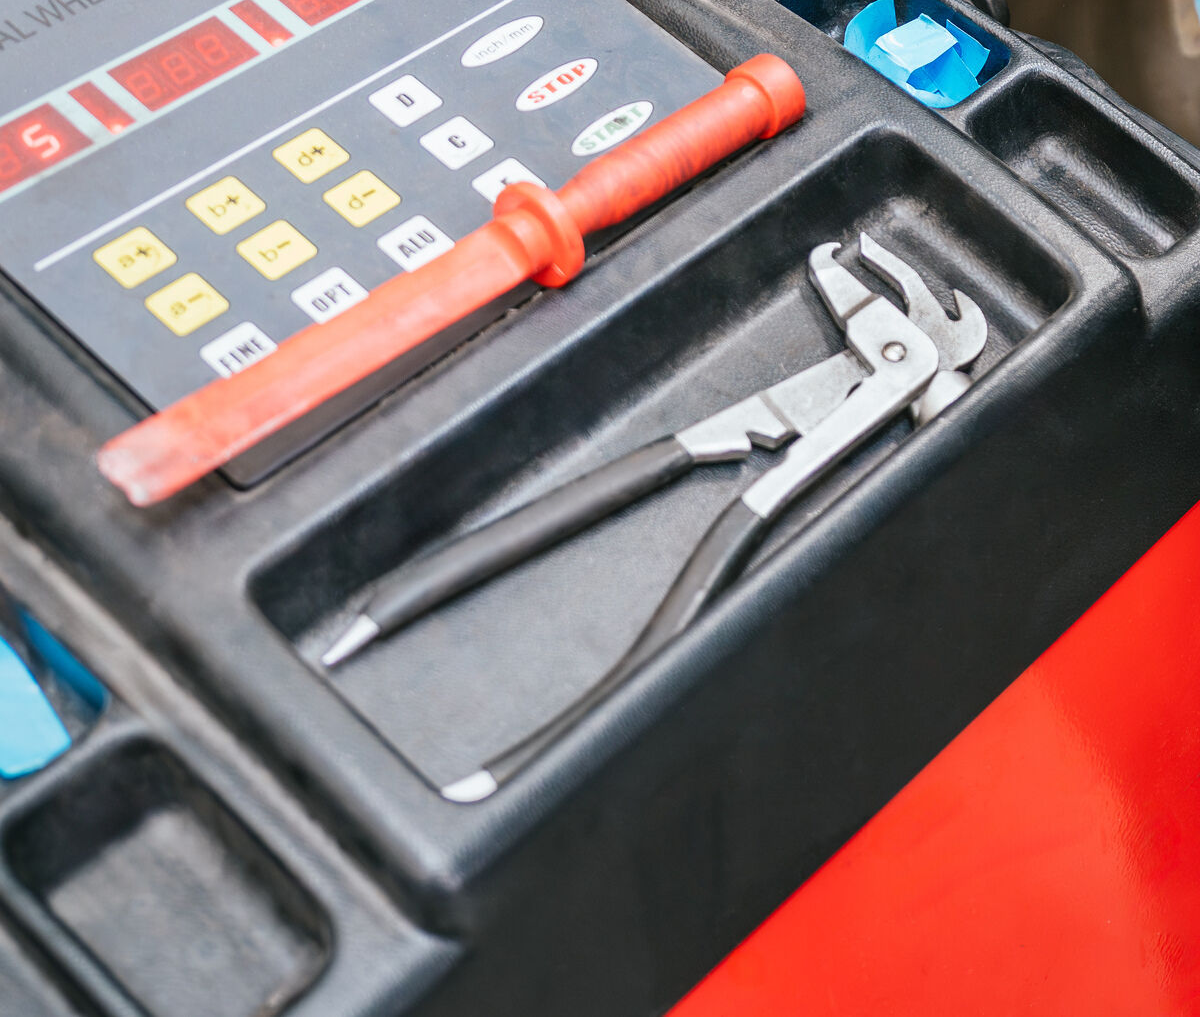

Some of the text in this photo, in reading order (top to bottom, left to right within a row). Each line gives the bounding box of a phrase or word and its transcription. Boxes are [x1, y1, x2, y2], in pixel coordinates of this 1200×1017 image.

[475, 22, 534, 60] inch/mm
[527, 63, 586, 103] STOP
[396, 93, 415, 107] D
[579, 105, 644, 151] START
[298, 144, 325, 167] d+
[448, 135, 466, 149] C
[207, 194, 240, 218] b+
[117, 244, 152, 269] a+
[397, 230, 435, 259] ALU
[311, 282, 352, 313] OPT
